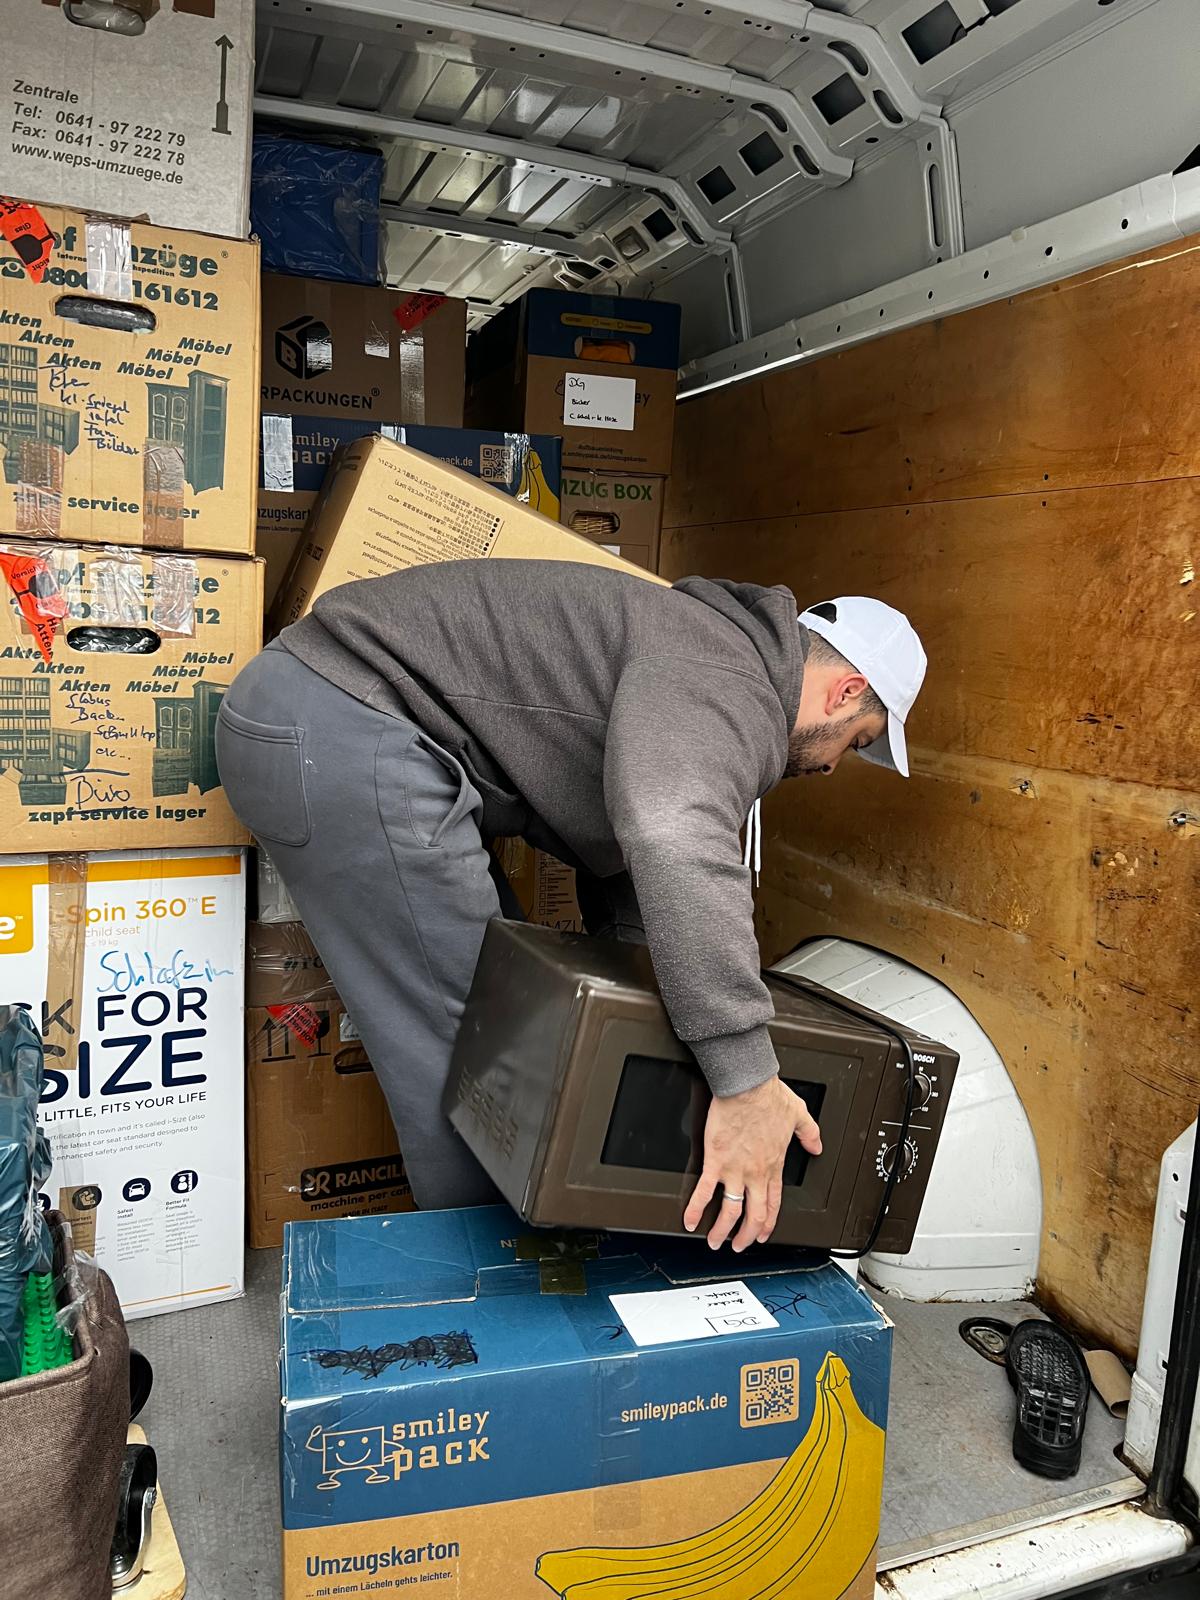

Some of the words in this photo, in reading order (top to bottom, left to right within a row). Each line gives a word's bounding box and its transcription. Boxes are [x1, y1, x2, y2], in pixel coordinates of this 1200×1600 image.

[12, 79, 79, 104] Zentrale
[13, 101, 42, 119] Tel:
[55, 110, 93, 129] 0641
[110, 120, 129, 136] 97
[134, 125, 162, 142] 222
[167, 131, 186, 147] 79
[12, 121, 47, 139] Fax:
[55, 129, 93, 148] 0641
[109, 139, 129, 154] 97
[134, 144, 161, 161] 222
[167, 151, 186, 166] 78
[11, 142, 184, 184] www.weps-umzuege.de
[0, 309, 42, 329] kten
[19, 330, 75, 348] Akten
[177, 337, 232, 356] Möbel
[47, 353, 102, 370] Akten
[146, 348, 200, 367] Möbel
[117, 361, 173, 380] Möbel
[260, 386, 372, 410] RPACKUNGEN
[292, 432, 339, 451] miley
[614, 484, 653, 501] BOX
[67, 496, 140, 514] service
[182, 652, 234, 664] Möbel
[32, 662, 85, 675] Akten
[152, 666, 205, 678] Möbel
[59, 680, 111, 692] Akten
[125, 680, 179, 693] Möbel
[28, 807, 74, 825] zapf
[79, 806, 149, 821] service
[155, 805, 207, 822] lager
[135, 897, 187, 920] 360
[201, 895, 217, 915] E
[84, 927, 112, 939] child
[117, 926, 141, 936] seat
[98, 987, 208, 1031] FOR
[913, 1053, 936, 1064] BOSCH
[44, 1106, 97, 1122] LITTLE,
[101, 1101, 131, 1115] FITS
[135, 1096, 174, 1110] YOUR
[178, 1091, 207, 1104] LIFE
[50, 1130, 87, 1141] rtification
[310, 1195, 365, 1212] macchine
[368, 1190, 388, 1204] per
[390, 1187, 410, 1198] caff
[392, 1408, 490, 1441] smiley
[392, 1437, 490, 1481] pack
[621, 1393, 728, 1423] smileypack.de
[306, 1541, 460, 1577] Umzugskarton
[316, 1586, 330, 1597] mit
[332, 1583, 359, 1596] einem
[360, 1578, 393, 1591] Lächeln
[395, 1575, 418, 1589] gehts
[420, 1570, 453, 1584] leichter.
